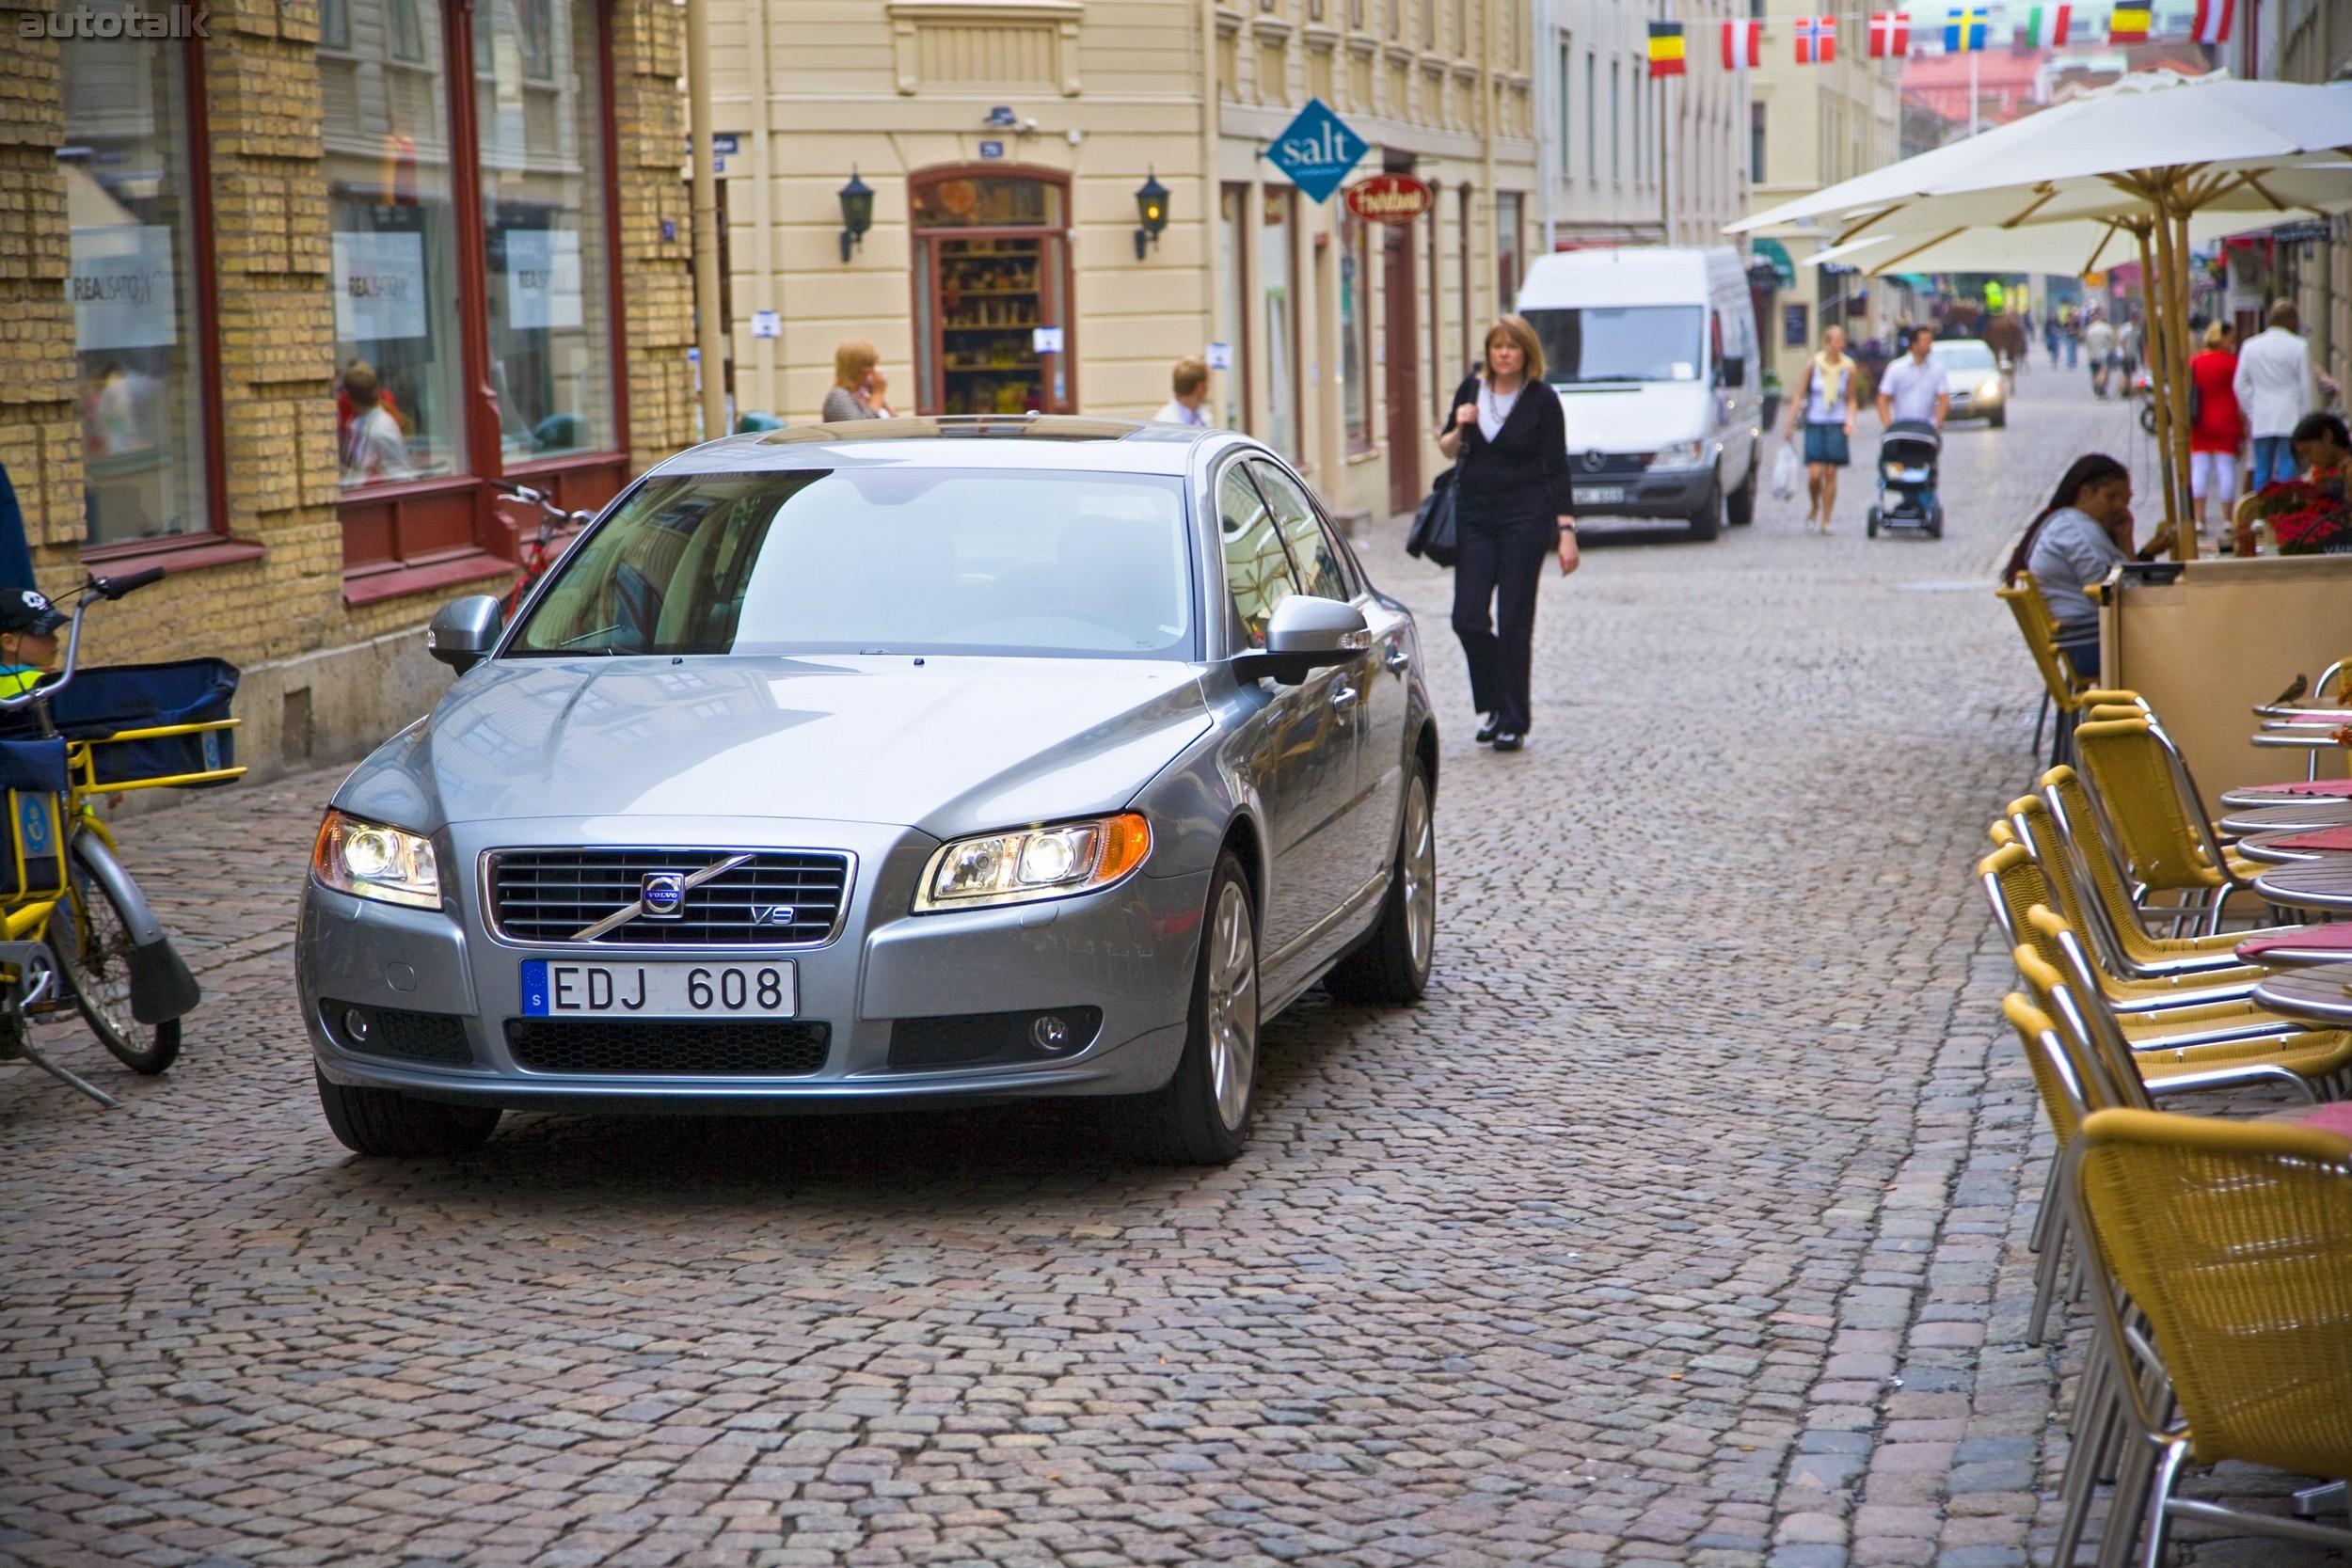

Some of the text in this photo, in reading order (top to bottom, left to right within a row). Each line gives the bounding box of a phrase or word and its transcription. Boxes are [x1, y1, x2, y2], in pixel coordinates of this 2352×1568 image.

[1281, 119, 1351, 166] salt
[751, 906, 795, 926] V8
[532, 993, 542, 1006] S
[554, 966, 783, 1011] EDJ 608
